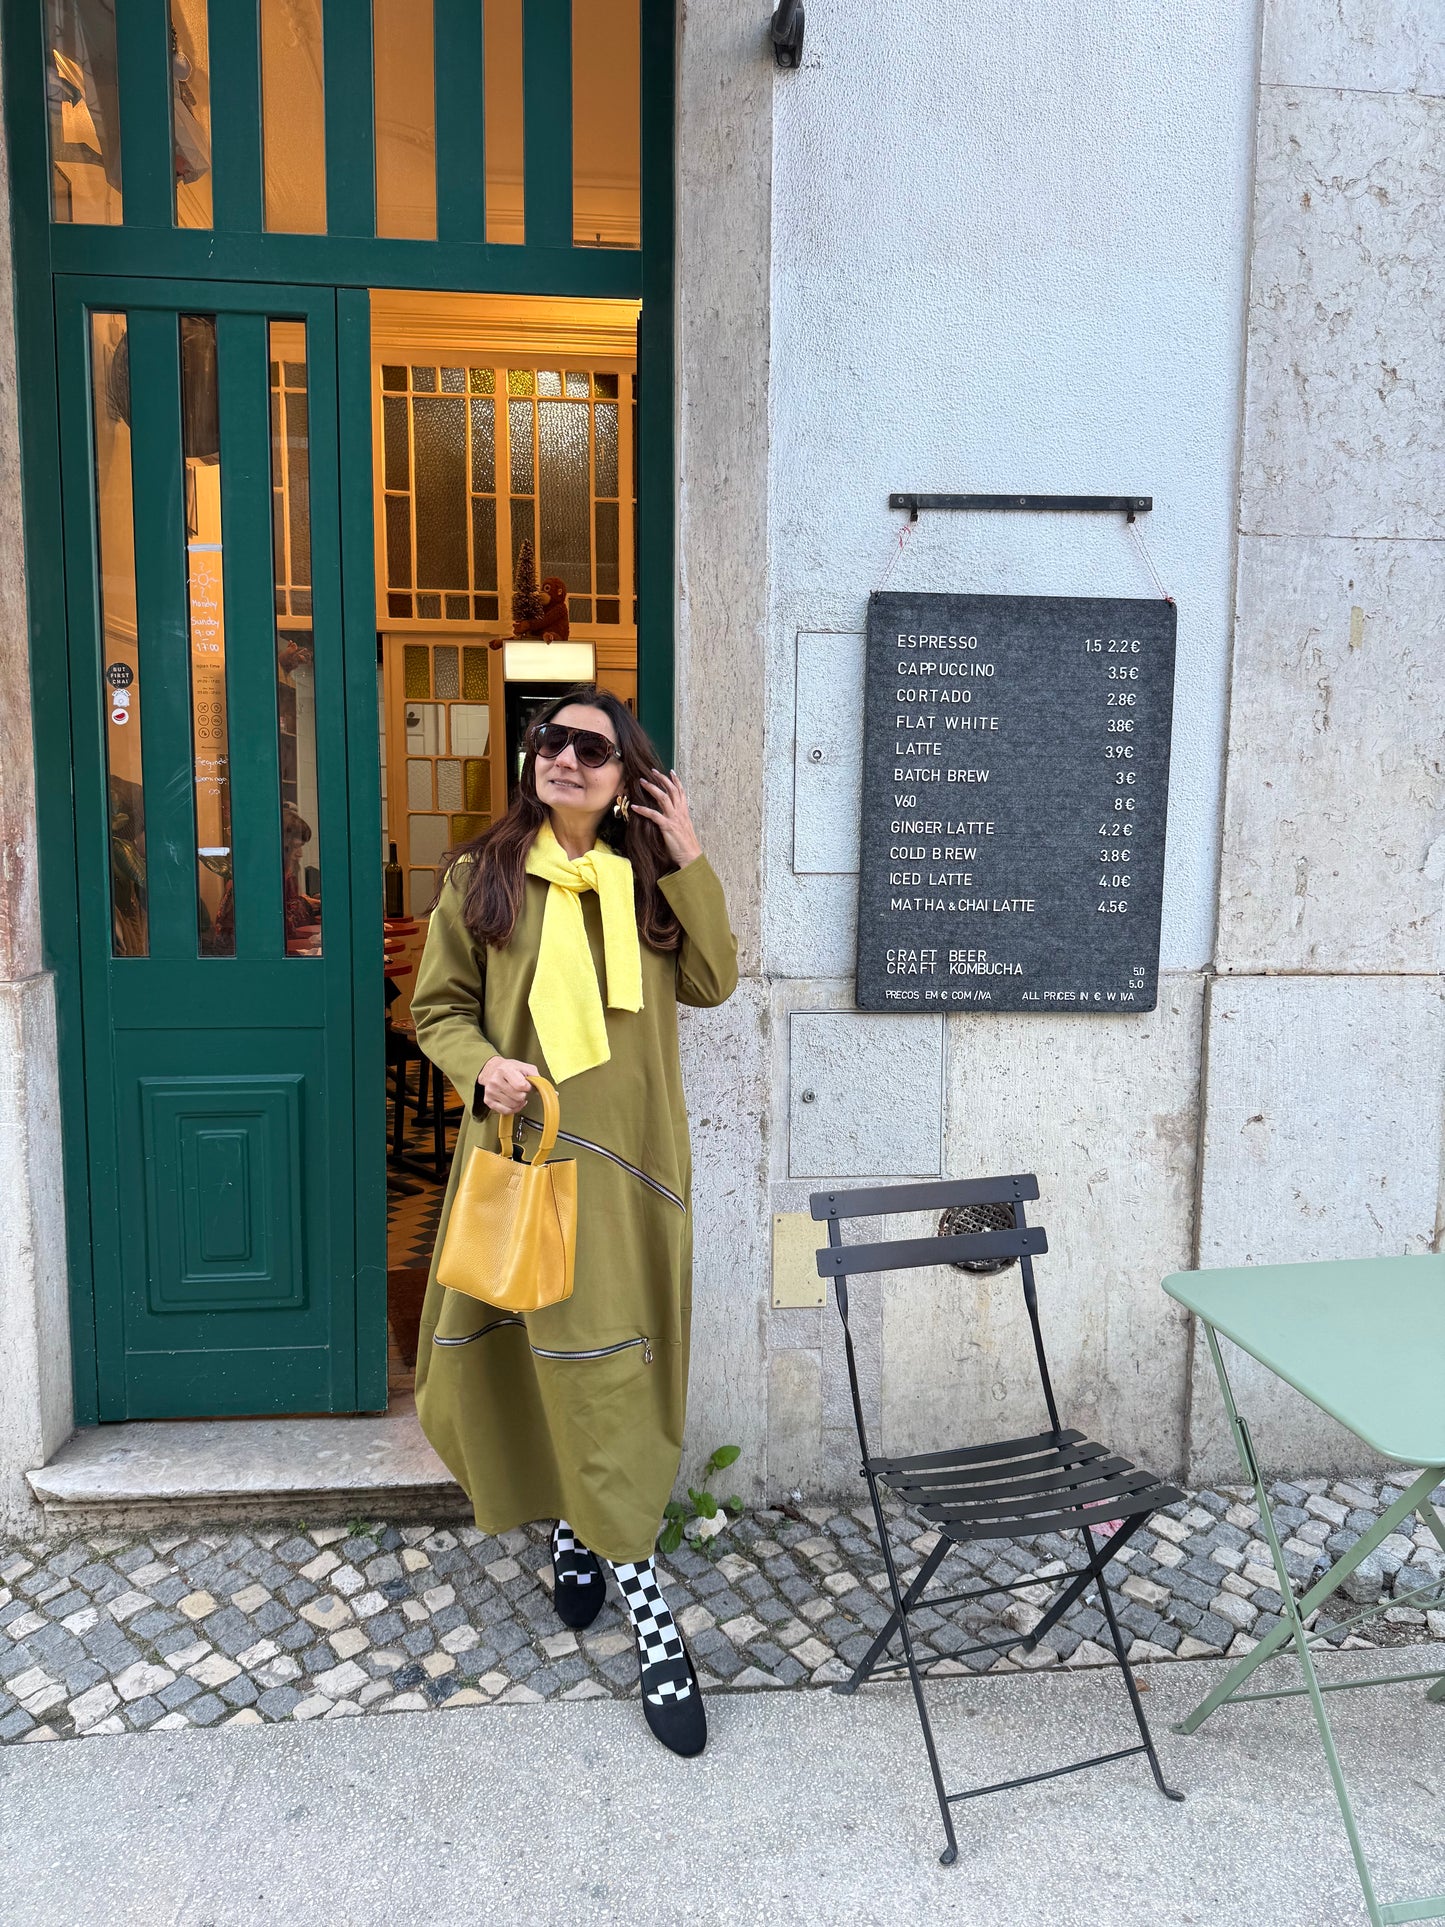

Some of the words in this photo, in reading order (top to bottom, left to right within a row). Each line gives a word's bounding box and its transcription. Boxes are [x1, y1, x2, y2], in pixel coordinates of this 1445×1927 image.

[191, 600, 217, 610] Monday
[190, 616, 219, 628] Sunday
[196, 643, 219, 651] 17:00
[897, 634, 978, 650] ESPRESSO
[1084, 638, 1103, 653] 1.5
[897, 661, 996, 678] CAPPUCCINO
[896, 689, 972, 704] CORTADO
[896, 715, 936, 729] FLAT
[944, 716, 1000, 731] WHITE
[895, 741, 943, 756] LATTE
[893, 768, 941, 783] BATCH
[947, 769, 990, 783] BREW
[894, 794, 917, 808] V60
[890, 820, 943, 835] GINGER
[946, 821, 995, 835] LATTE
[889, 846, 927, 861] COLD
[932, 847, 977, 861] BREW
[889, 872, 921, 886] ICED
[929, 872, 973, 886] LATTE
[890, 897, 946, 912] MATHA
[948, 901, 956, 911] &
[957, 898, 988, 912] CHAI
[992, 899, 1036, 912] LATTE
[885, 948, 938, 962] CRAFT
[948, 949, 988, 962] BEER
[886, 961, 938, 975] CRAFT
[949, 962, 1024, 976] KOMBUCHA
[1128, 977, 1144, 989] 5.0
[924, 990, 939, 1000] EM
[951, 990, 972, 1000] COM
[1021, 991, 1041, 1001] ALL
[1043, 990, 1076, 1001] PRICES
[1079, 991, 1089, 1002] IN
[1106, 991, 1117, 1001] W
[1120, 991, 1135, 1002] IVA
